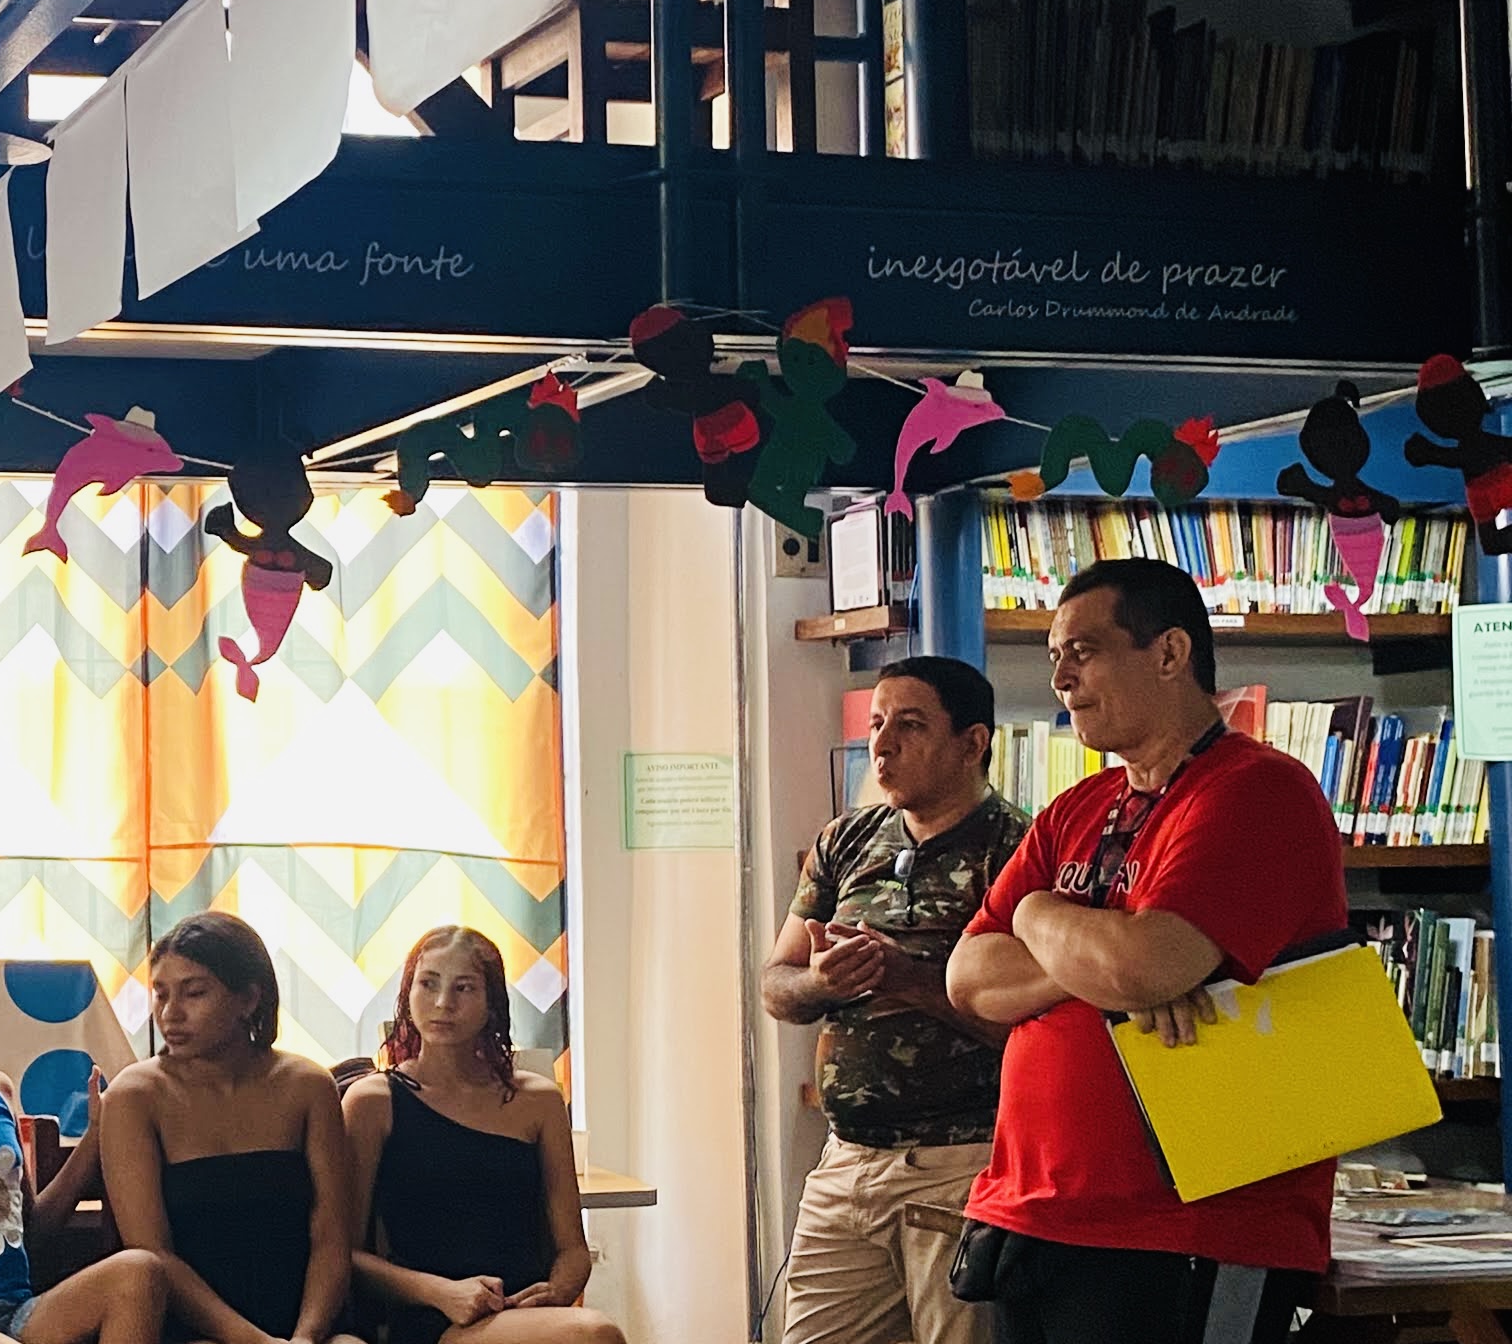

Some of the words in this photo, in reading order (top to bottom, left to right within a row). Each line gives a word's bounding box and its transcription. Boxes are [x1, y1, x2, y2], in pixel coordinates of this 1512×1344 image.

[243, 246, 349, 273] uma
[360, 241, 475, 286] fonte
[867, 246, 1090, 290] inesgotável
[1100, 250, 1152, 284] de
[1161, 258, 1287, 294] prazer
[968, 298, 1039, 319] Carlos
[1045, 299, 1170, 320] Drummond
[1175, 302, 1201, 320] de
[1206, 302, 1299, 322] Andrade
